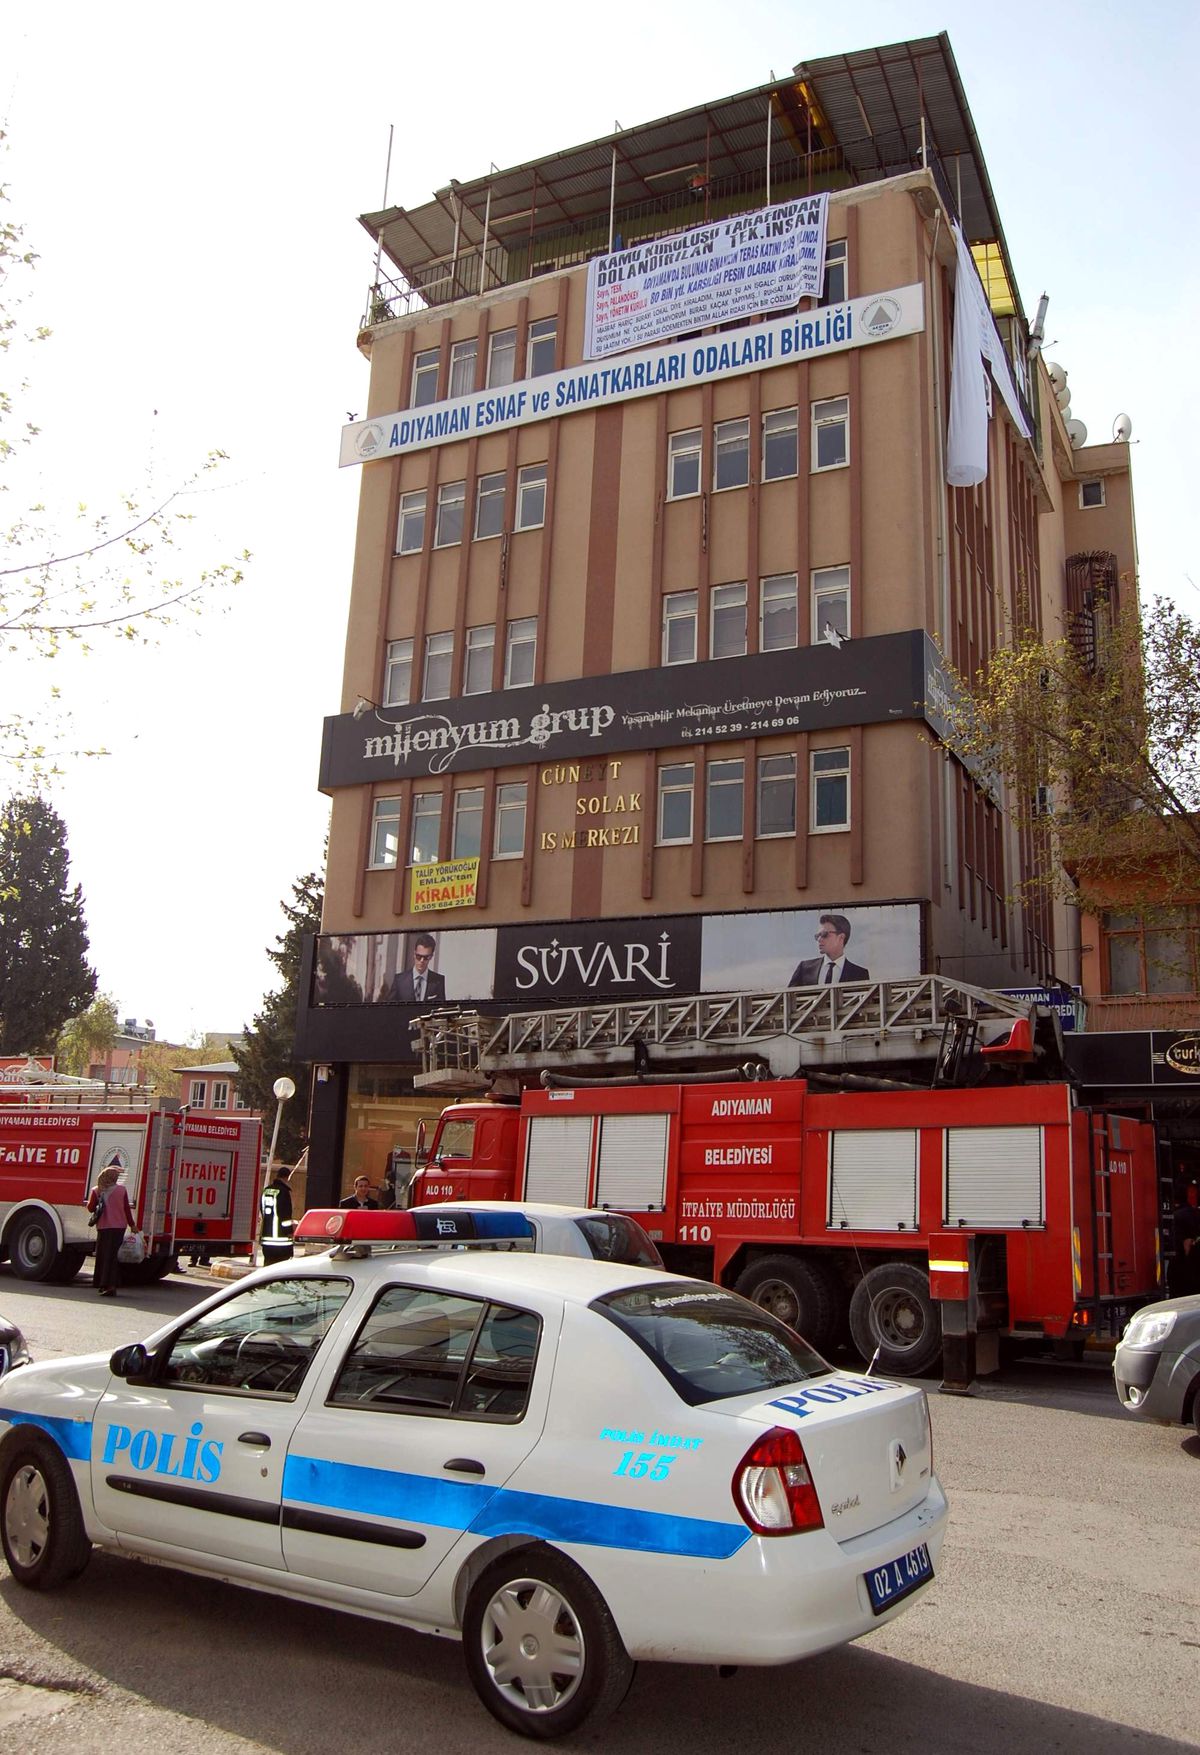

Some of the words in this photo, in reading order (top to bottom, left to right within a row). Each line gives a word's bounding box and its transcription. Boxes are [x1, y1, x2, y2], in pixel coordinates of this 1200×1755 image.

[599, 250, 641, 272] KAMU
[725, 198, 821, 235] TARAFINDAN
[740, 245, 758, 263] TERAS
[747, 260, 776, 278] OLARAK
[389, 404, 470, 448] ADIYAMAN
[475, 390, 527, 428] ESNAF
[532, 391, 550, 413] ve
[555, 352, 687, 405] SANATKARLARI
[692, 339, 773, 376] ODALARI
[780, 306, 853, 359] BİRLİĞİ
[530, 703, 616, 747] grup
[774, 693, 811, 712] Devam
[695, 725, 713, 737] 214
[715, 723, 728, 735] 52
[730, 721, 742, 733] 39
[750, 719, 769, 732] 214
[771, 718, 784, 729] 69
[785, 716, 799, 727] 06
[576, 792, 641, 815] SOLAK
[415, 882, 475, 905] KİRALIK
[515, 931, 677, 990] SÜVARİ
[711, 1098, 772, 1117] ADIYAMAN
[33, 1116, 80, 1127] BELEDİYESİ
[55, 1148, 80, 1164] 110
[704, 1145, 773, 1166] BELEDİYESİ
[180, 1159, 227, 1182] İTFAİYE
[186, 1186, 216, 1206] 110
[426, 1185, 439, 1195] ALO
[441, 1185, 453, 1195] 110
[682, 1197, 723, 1218] İTFAİYE
[726, 1198, 796, 1219] MÜDÜRLÜĞÜ
[679, 1225, 712, 1241] 110
[102, 1422, 224, 1483] POLİS
[611, 1450, 678, 1481] 155
[874, 1570, 891, 1599] 02
[893, 1563, 904, 1586] A
[905, 1546, 928, 1580] 4613
